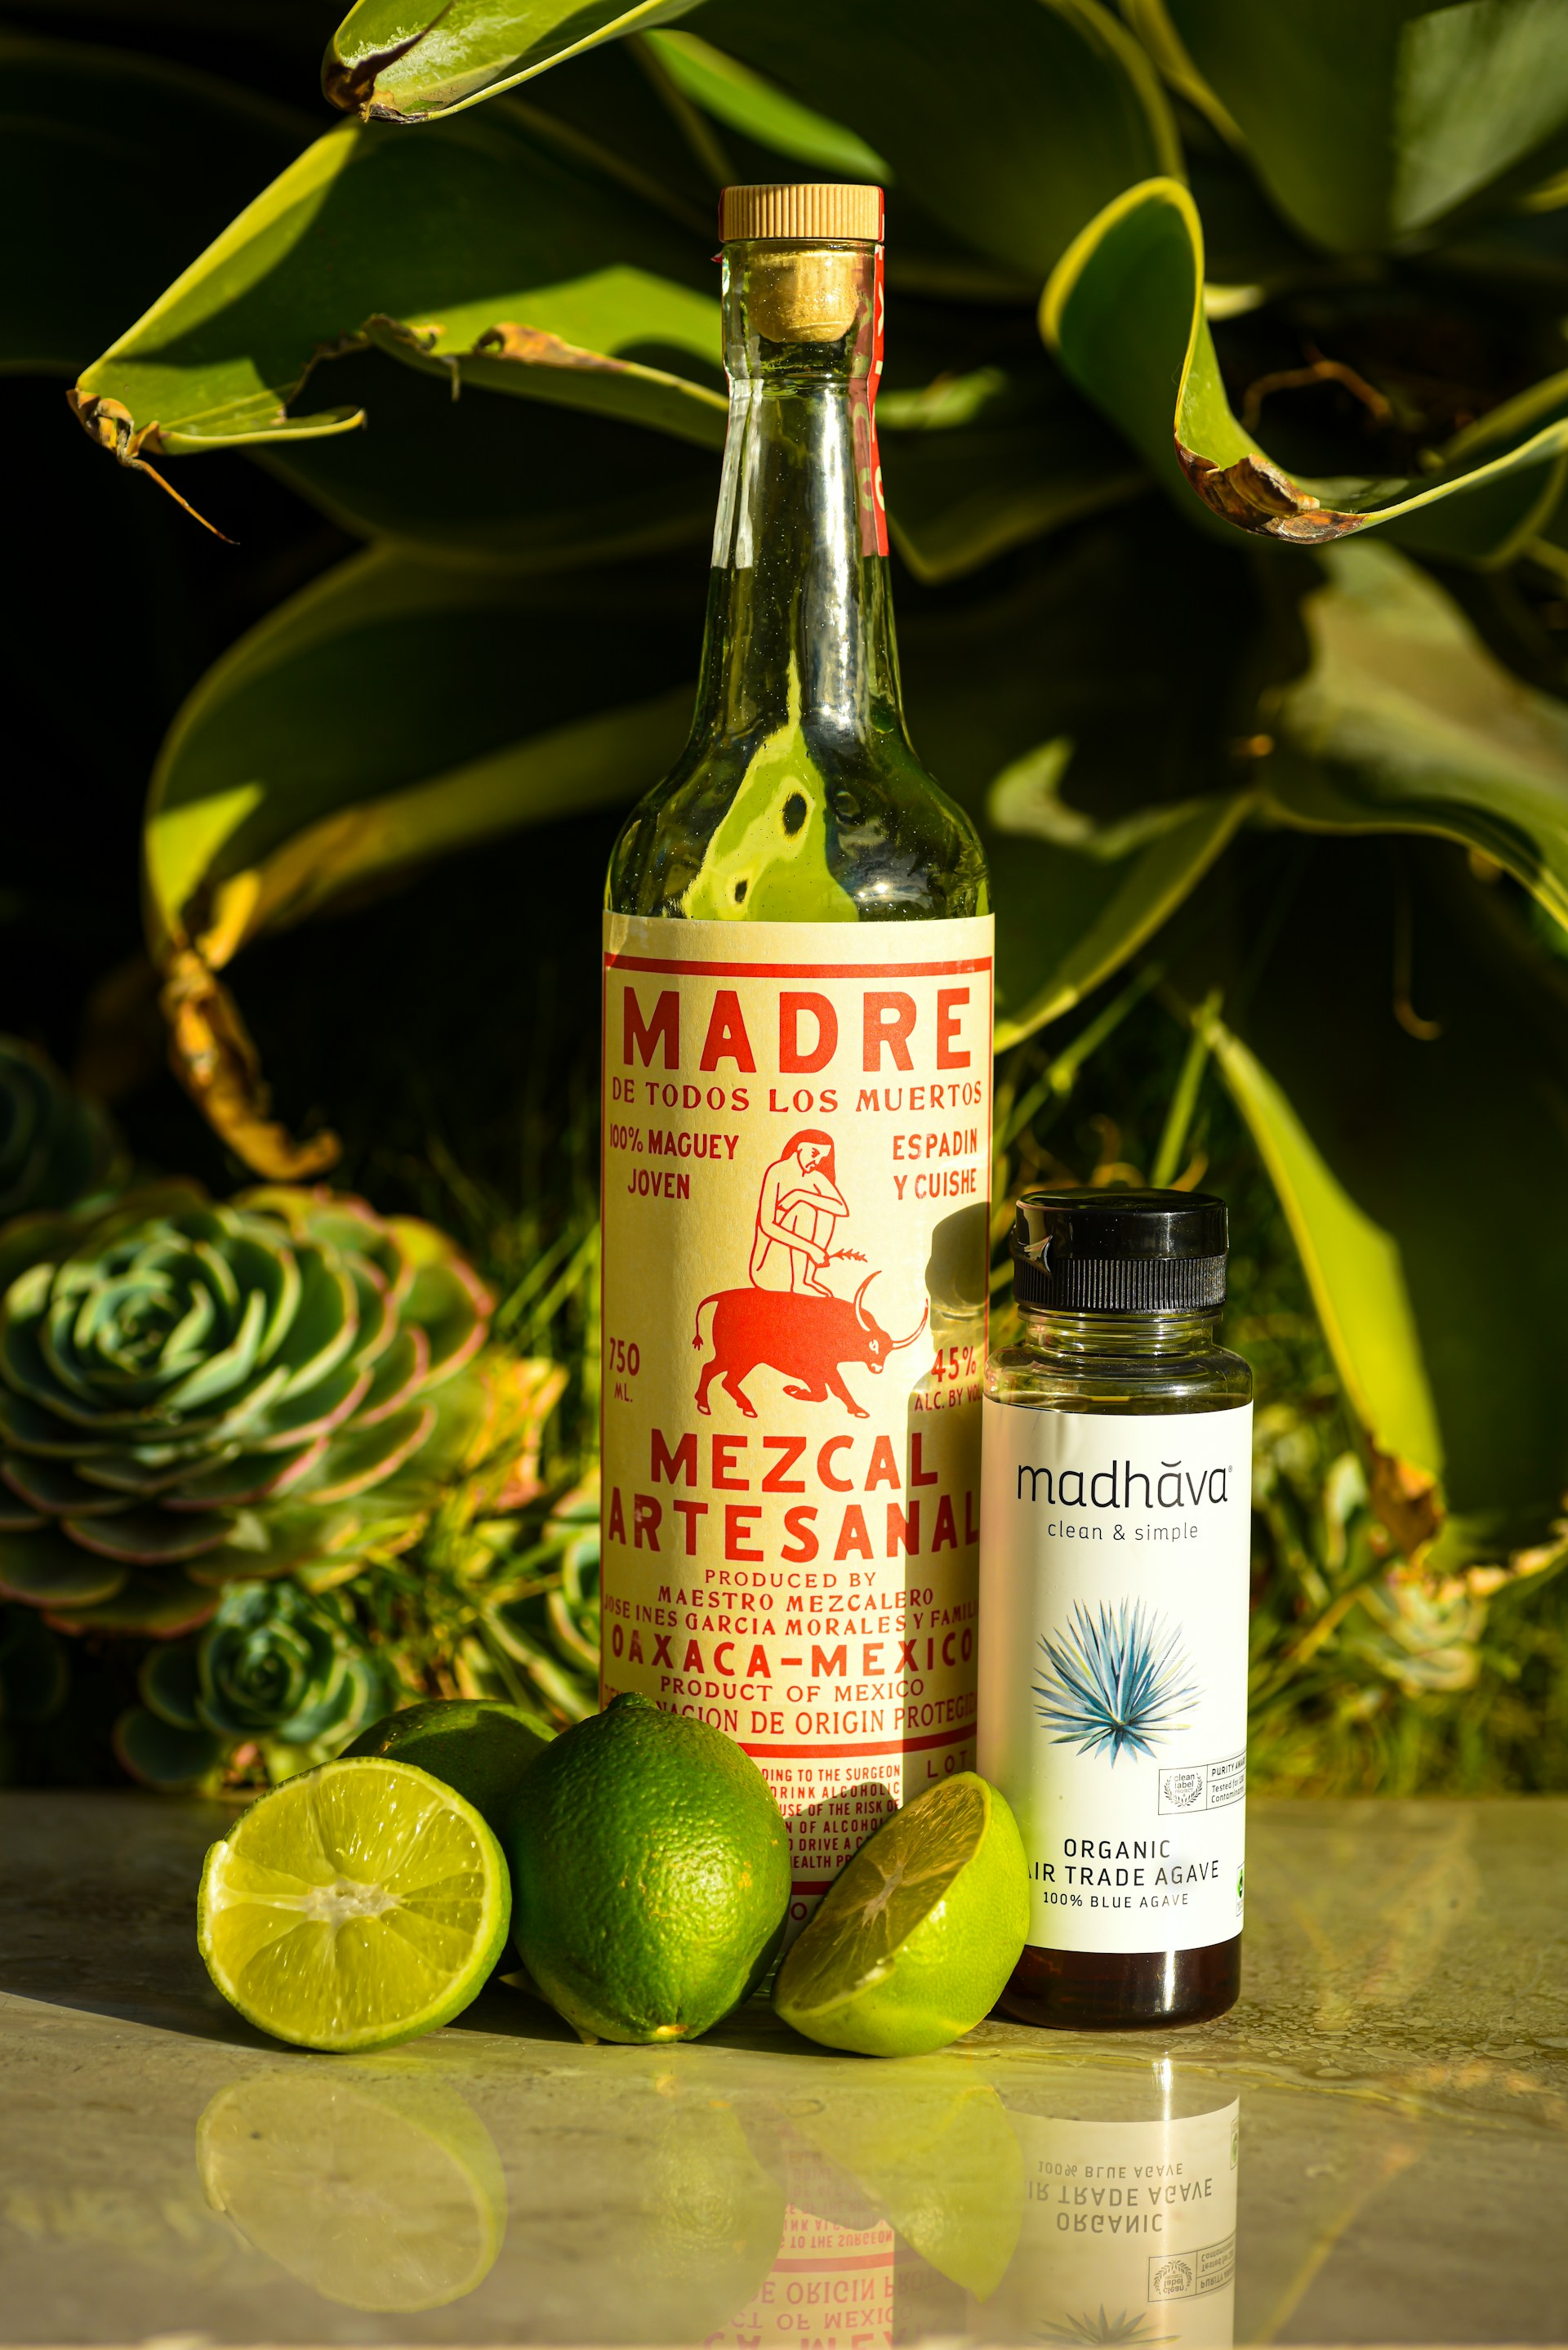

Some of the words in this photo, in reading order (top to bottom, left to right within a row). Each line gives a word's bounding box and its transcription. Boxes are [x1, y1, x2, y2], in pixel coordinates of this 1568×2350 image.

[623, 986, 971, 1073] MADRE
[612, 1076, 635, 1104] DE
[645, 1081, 750, 1111] TODOS
[769, 1089, 839, 1113] LOS
[855, 1080, 982, 1112] MUERTOS
[609, 1123, 643, 1153] 100%
[648, 1129, 739, 1160] MAGUEY
[893, 1128, 978, 1160] ESPADIN
[627, 1167, 690, 1199] JOVEN
[893, 1175, 907, 1200] Y
[914, 1168, 977, 1198] CUISHE
[609, 1337, 640, 1377] 750
[931, 1346, 977, 1382] 45%
[614, 1382, 633, 1402] ML.
[915, 1391, 944, 1411] ALC.
[949, 1388, 963, 1407] BY
[651, 1429, 938, 1493] MEZCAL
[608, 1487, 979, 1563] ARTESANAL
[1048, 1520, 1102, 1540] clean
[1113, 1524, 1125, 1541] &
[1134, 1523, 1199, 1542] simple
[705, 1569, 837, 1588] PRODUCED
[850, 1572, 877, 1587] BY
[658, 1585, 773, 1612] MAESTRO
[786, 1587, 933, 1612] MEZCALERO
[604, 1594, 630, 1619] JOSE
[635, 1604, 678, 1627] INES
[685, 1612, 776, 1636] GARCIA
[786, 1614, 906, 1636] MORALES
[913, 1612, 924, 1630] Y
[661, 1675, 773, 1702] PRODUCT
[786, 1684, 821, 1702] OF
[835, 1678, 924, 1702] MEXICO
[751, 1710, 785, 1735] DE
[795, 1708, 884, 1736] ORIGIN
[798, 1769, 813, 1782] TO
[818, 1768, 840, 1781] THE
[846, 1764, 901, 1781] SURGEON
[1174, 1773, 1195, 1781] clean
[1211, 1763, 1235, 1777] PURITY
[822, 1781, 900, 1799] ALCOHOLIC
[1174, 1780, 1194, 1789] label
[1212, 1781, 1232, 1793] Tested
[808, 1803, 823, 1817] OF
[829, 1803, 850, 1816] THE
[855, 1799, 883, 1814] RISK
[800, 1821, 817, 1834] OF
[799, 1838, 839, 1852] DRIVE
[844, 1837, 851, 1850] A
[1063, 1838, 1170, 1859] ORGANIC
[1065, 1866, 1145, 1887] TRADE
[1155, 1860, 1219, 1886] AGAVE
[1043, 1891, 1083, 1906] 100%
[1090, 1895, 1132, 1908] BLUE
[1139, 1893, 1189, 1908] AGAVE
